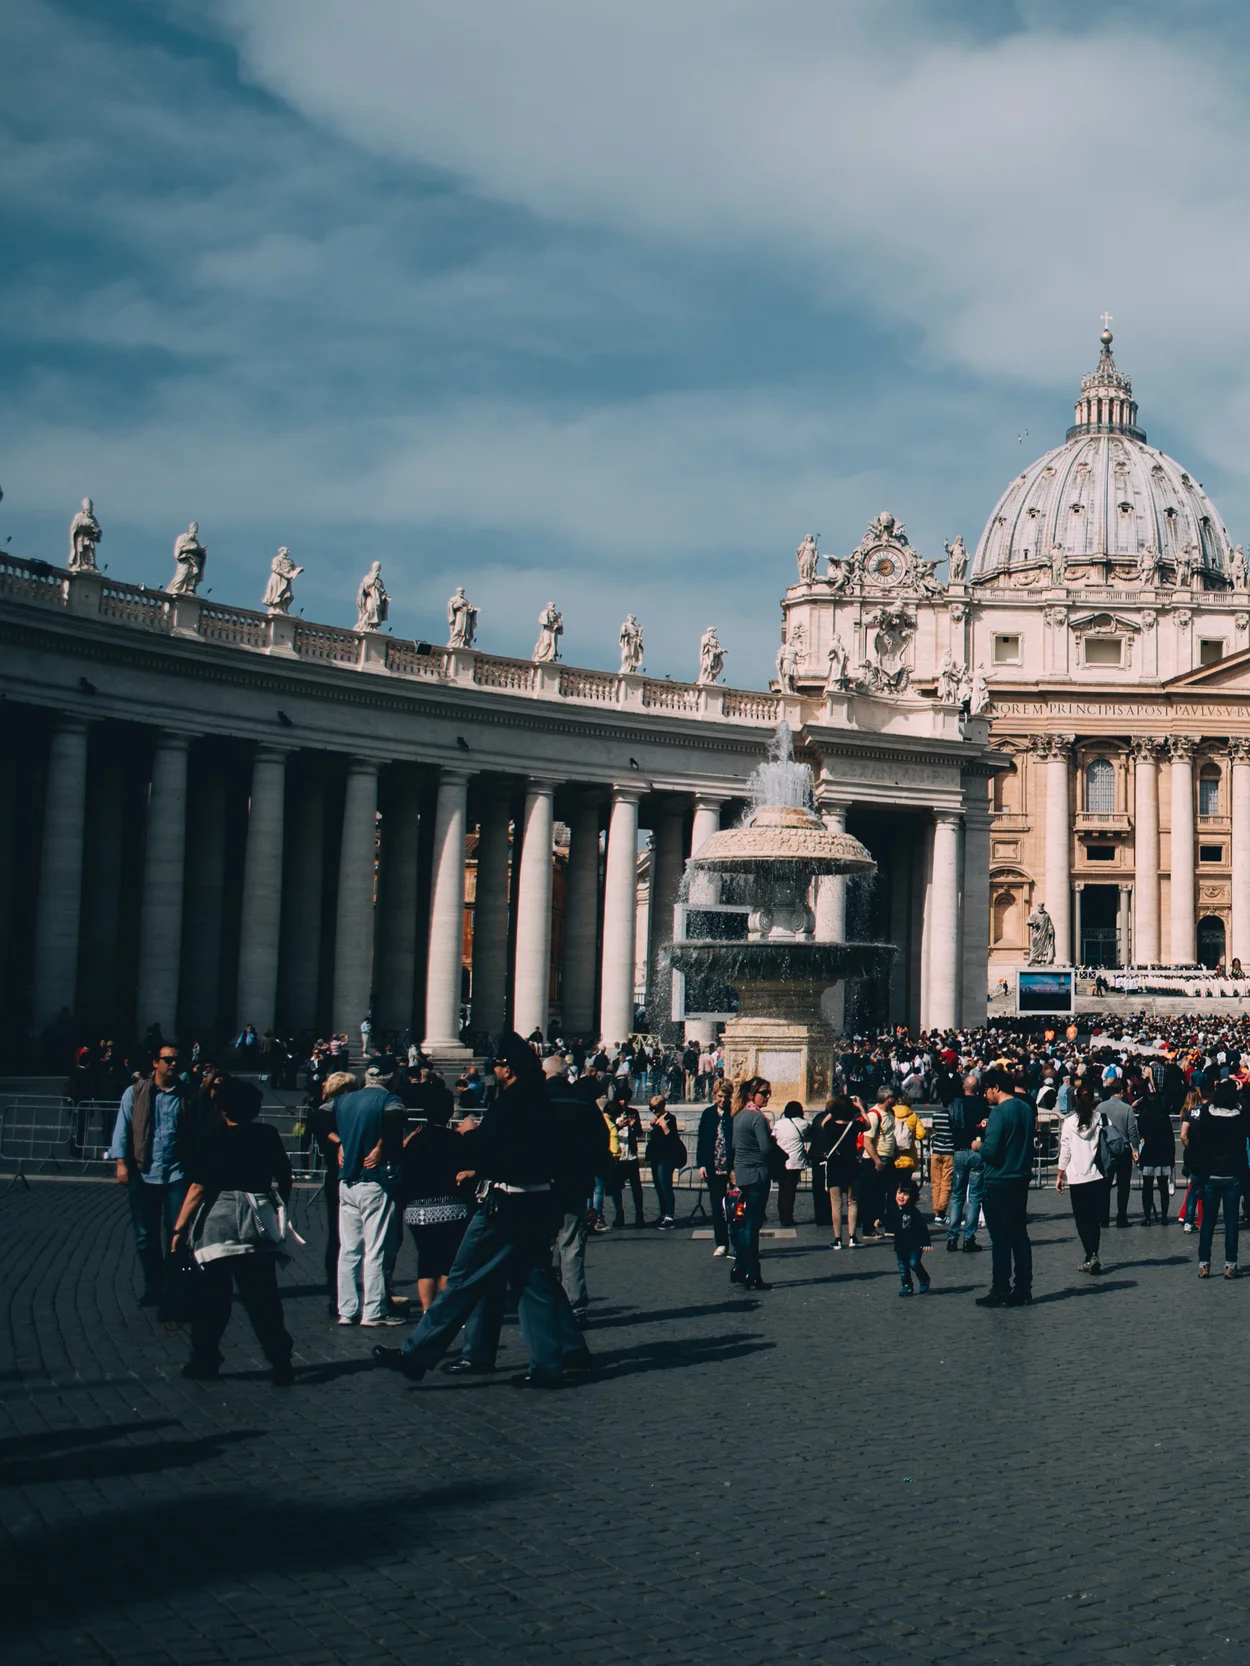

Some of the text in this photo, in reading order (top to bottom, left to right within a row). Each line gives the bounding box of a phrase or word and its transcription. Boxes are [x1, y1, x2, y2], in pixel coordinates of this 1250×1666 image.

[980, 702, 1043, 715] ONOREM
[1049, 702, 1124, 716] PRINCIPIS
[1126, 704, 1169, 716] APOST
[1175, 704, 1222, 717] PAVLVS
